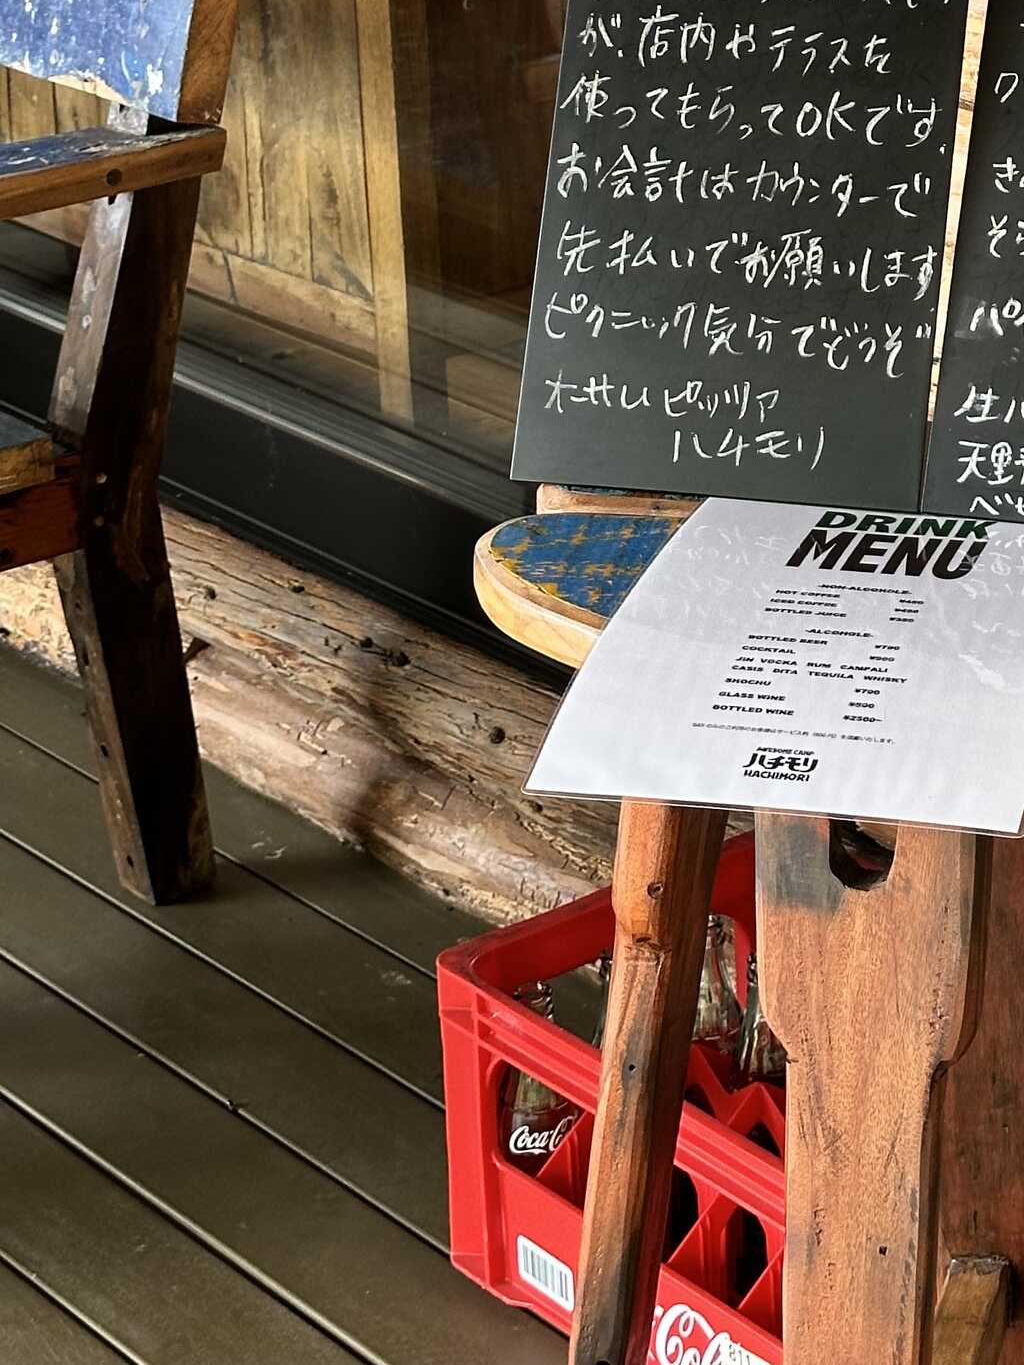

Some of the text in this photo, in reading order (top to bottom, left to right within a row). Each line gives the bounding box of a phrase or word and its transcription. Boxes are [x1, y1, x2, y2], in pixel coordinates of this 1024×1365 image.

[672, 425, 825, 471] ハチモリ
[815, 510, 998, 539] DRINK
[785, 528, 989, 580] MENU
[800, 591, 841, 599] COFFEE
[797, 600, 838, 608] COFFEE
[764, 607, 812, 616] BOTTLED
[814, 610, 848, 618] JUICE
[748, 634, 797, 643] BOTTLED
[799, 638, 829, 646] BEER
[742, 645, 797, 655] COCKTAIL
[806, 661, 832, 669] RUM
[725, 677, 772, 686] SHOCHU
[808, 670, 855, 680] TEQUILA
[863, 675, 908, 684] WHISKY
[718, 691, 754, 699] GLASS
[757, 693, 786, 702] WINE
[712, 704, 763, 714] BOTTLED
[765, 708, 795, 717] WINE
[756, 746, 792, 755] AWESOME
[742, 752, 819, 773] ハチモリ
[743, 769, 810, 782] HACHIMORI
